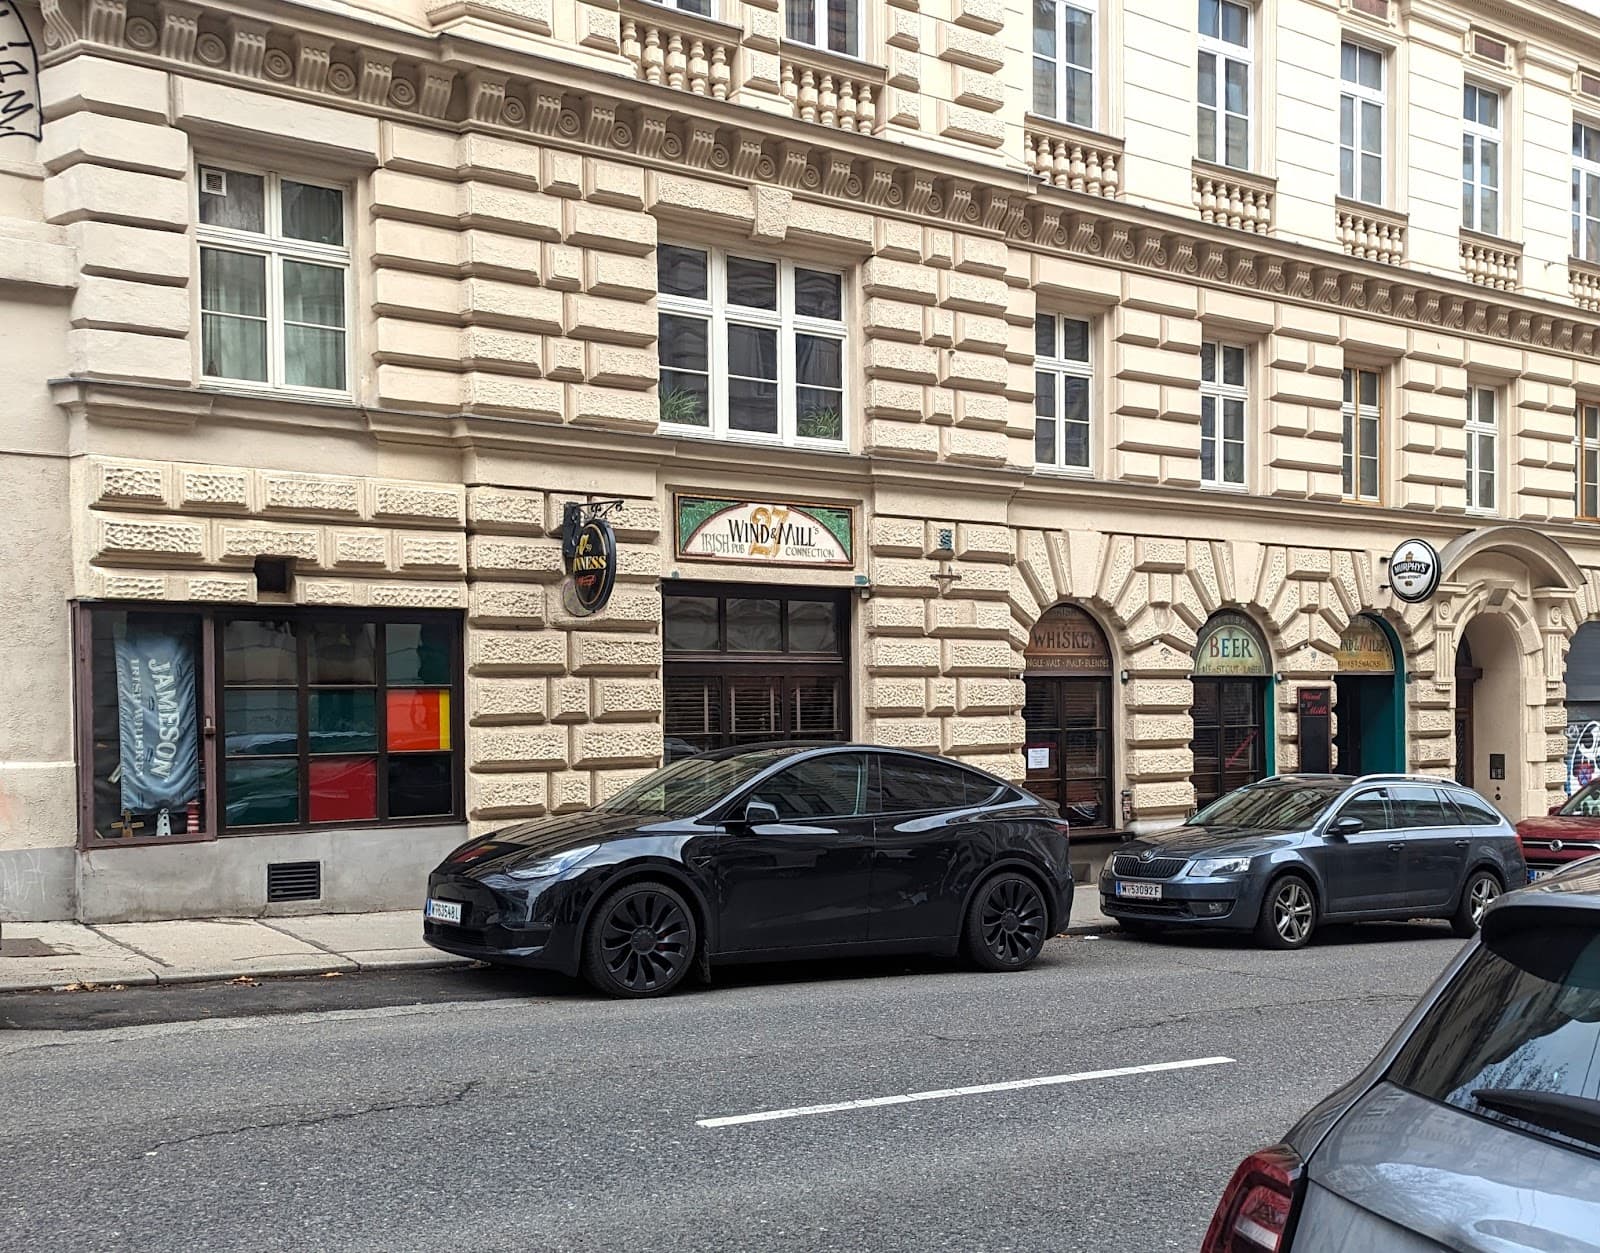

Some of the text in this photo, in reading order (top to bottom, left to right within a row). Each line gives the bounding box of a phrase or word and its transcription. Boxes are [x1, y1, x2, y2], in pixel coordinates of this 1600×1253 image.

[701, 532, 745, 554] IRISH PUB
[785, 546, 835, 559] CONNECTION
[1033, 631, 1097, 649] WHISKEY
[1209, 636, 1254, 658] BEER
[148, 658, 180, 783] JAMESON
